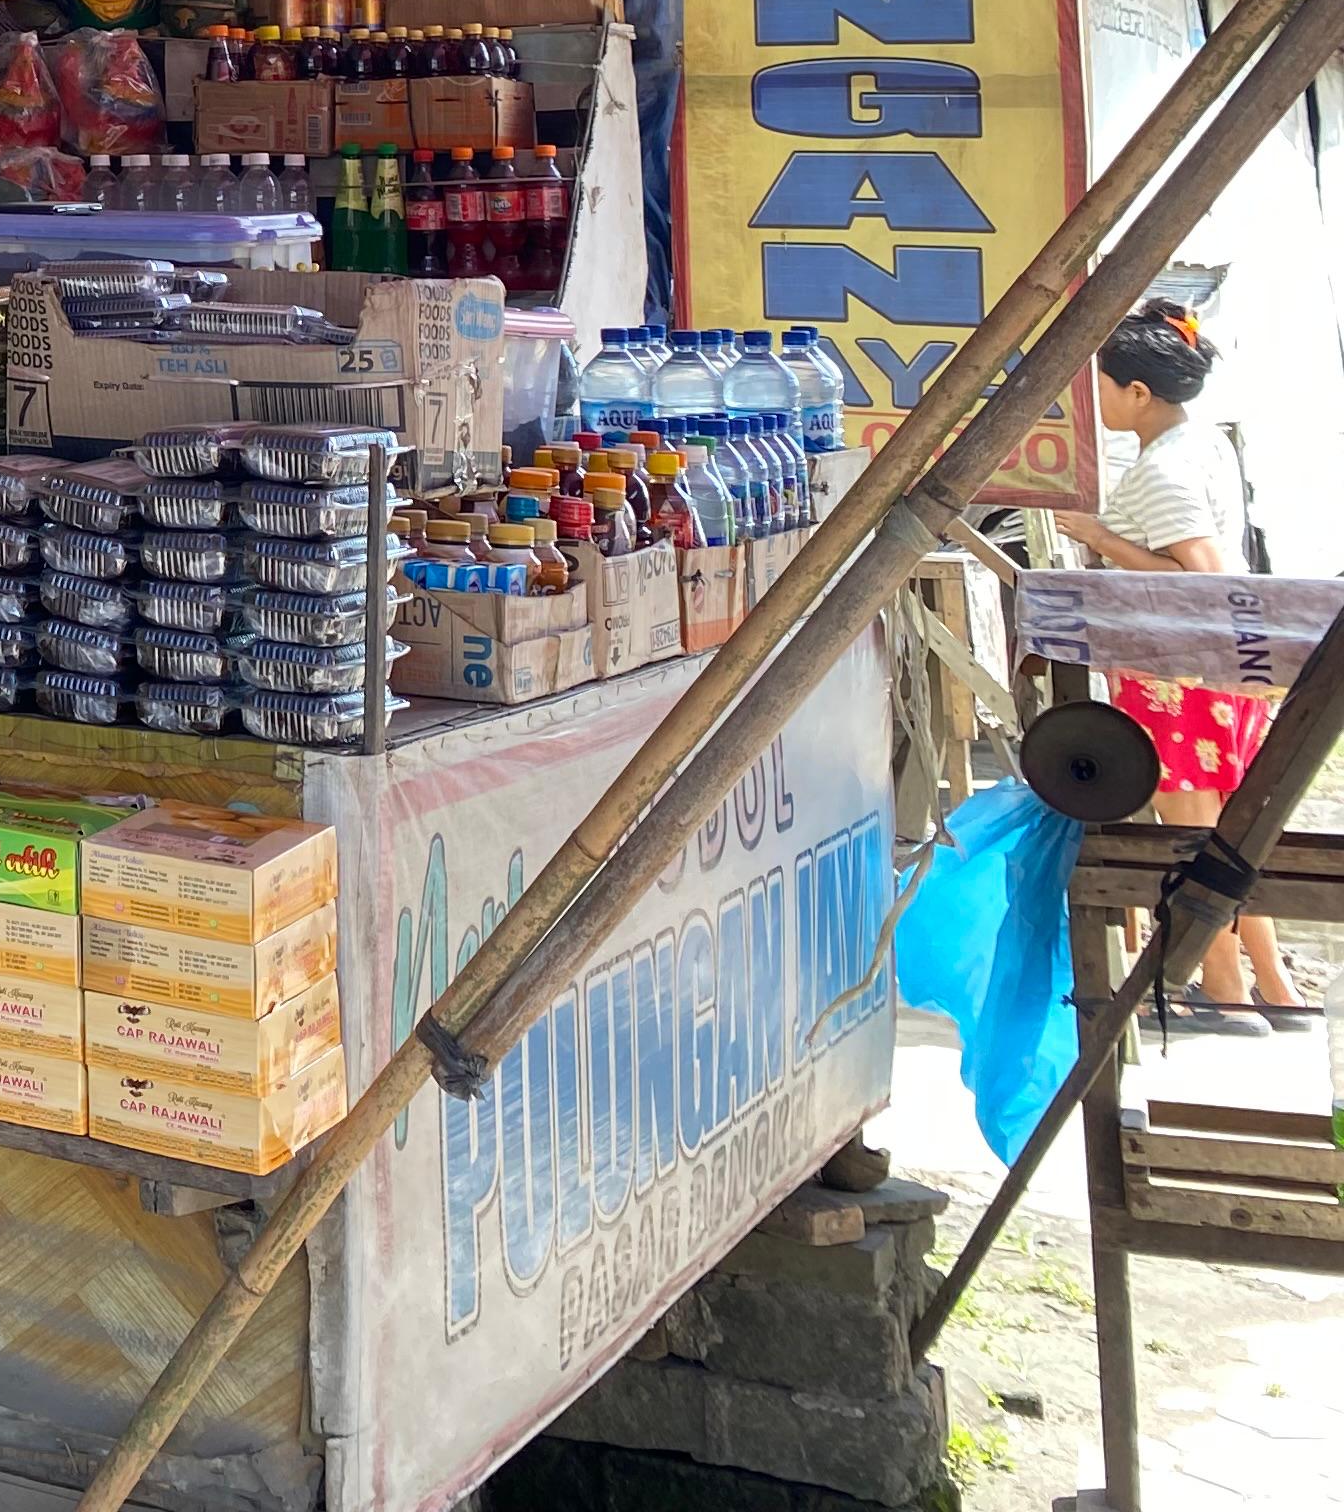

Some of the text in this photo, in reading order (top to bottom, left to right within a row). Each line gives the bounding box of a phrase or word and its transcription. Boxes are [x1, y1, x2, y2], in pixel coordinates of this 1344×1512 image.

[157, 358, 227, 374] TEH ASLI
[340, 349, 374, 373] 25
[13, 384, 37, 428] 7
[429, 399, 443, 445] 7
[117, 1025, 220, 1054] CAP RAJAWALI
[120, 1099, 222, 1130] CAP RAJAWALI
[439, 865, 785, 1346] PULUNGAN
